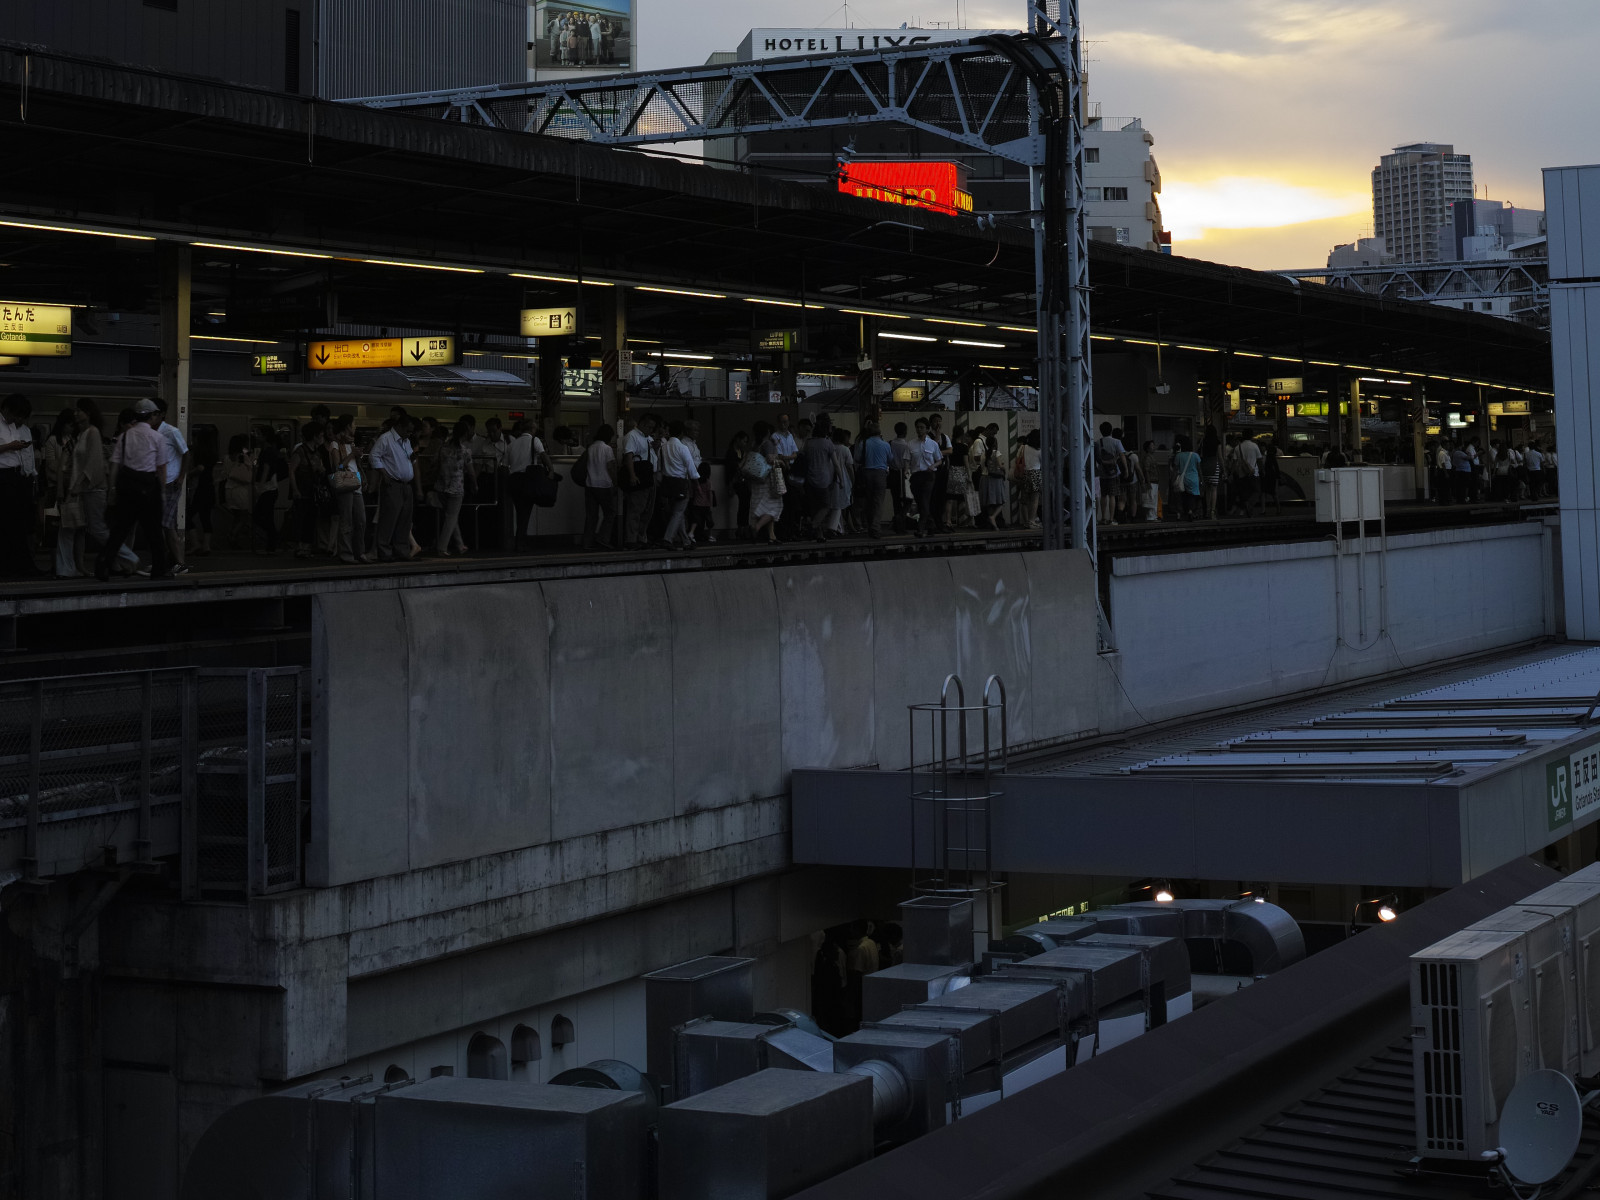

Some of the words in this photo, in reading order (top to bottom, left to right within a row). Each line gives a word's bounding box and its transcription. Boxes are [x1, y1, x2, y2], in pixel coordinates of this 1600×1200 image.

[765, 38, 829, 51] HOTEL
[0, 332, 26, 342] Gotanda
[791, 331, 797, 344] 1
[334, 344, 349, 353] 出口
[253, 356, 260, 368] 2
[1297, 404, 1304, 415] 2
[1574, 754, 1598, 789] 五反田
[1551, 765, 1568, 808] JR
[1536, 1101, 1559, 1112] CS
